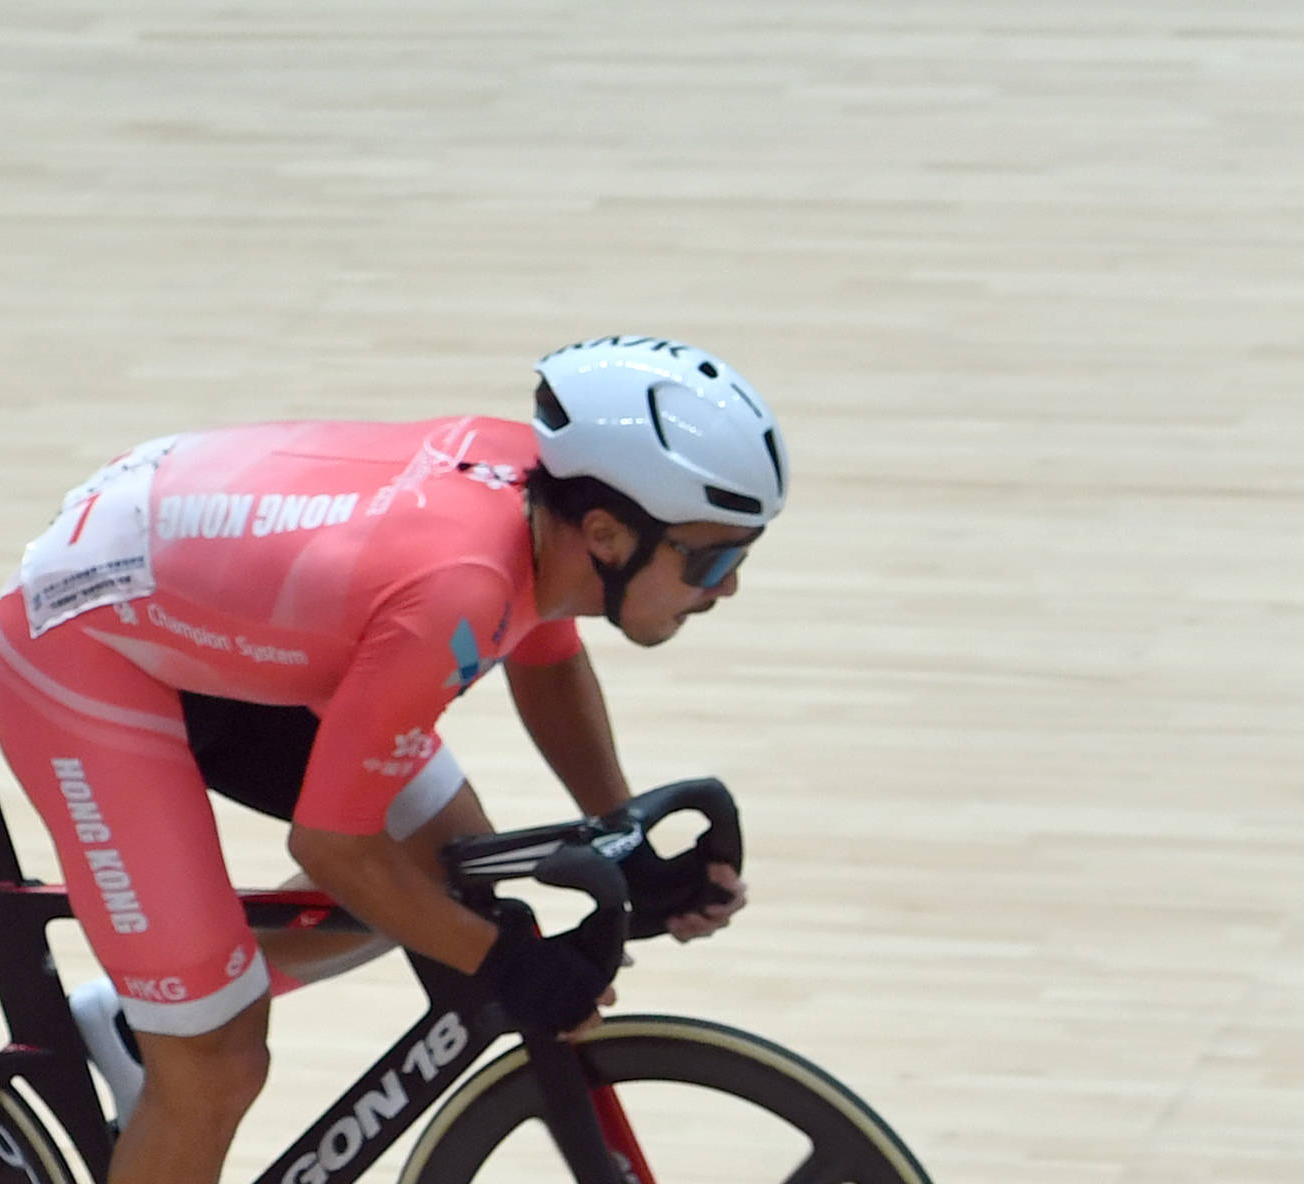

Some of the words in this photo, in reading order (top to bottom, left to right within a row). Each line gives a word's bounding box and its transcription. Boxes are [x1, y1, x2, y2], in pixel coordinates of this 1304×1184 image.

[158, 492, 253, 540] KONG
[251, 491, 361, 537] HONG
[147, 603, 231, 652] Champion
[233, 636, 309, 666] System
[51, 758, 112, 844] HONG
[85, 849, 150, 934] KONG
[124, 976, 188, 1001] HKG
[402, 1011, 468, 1083] 18
